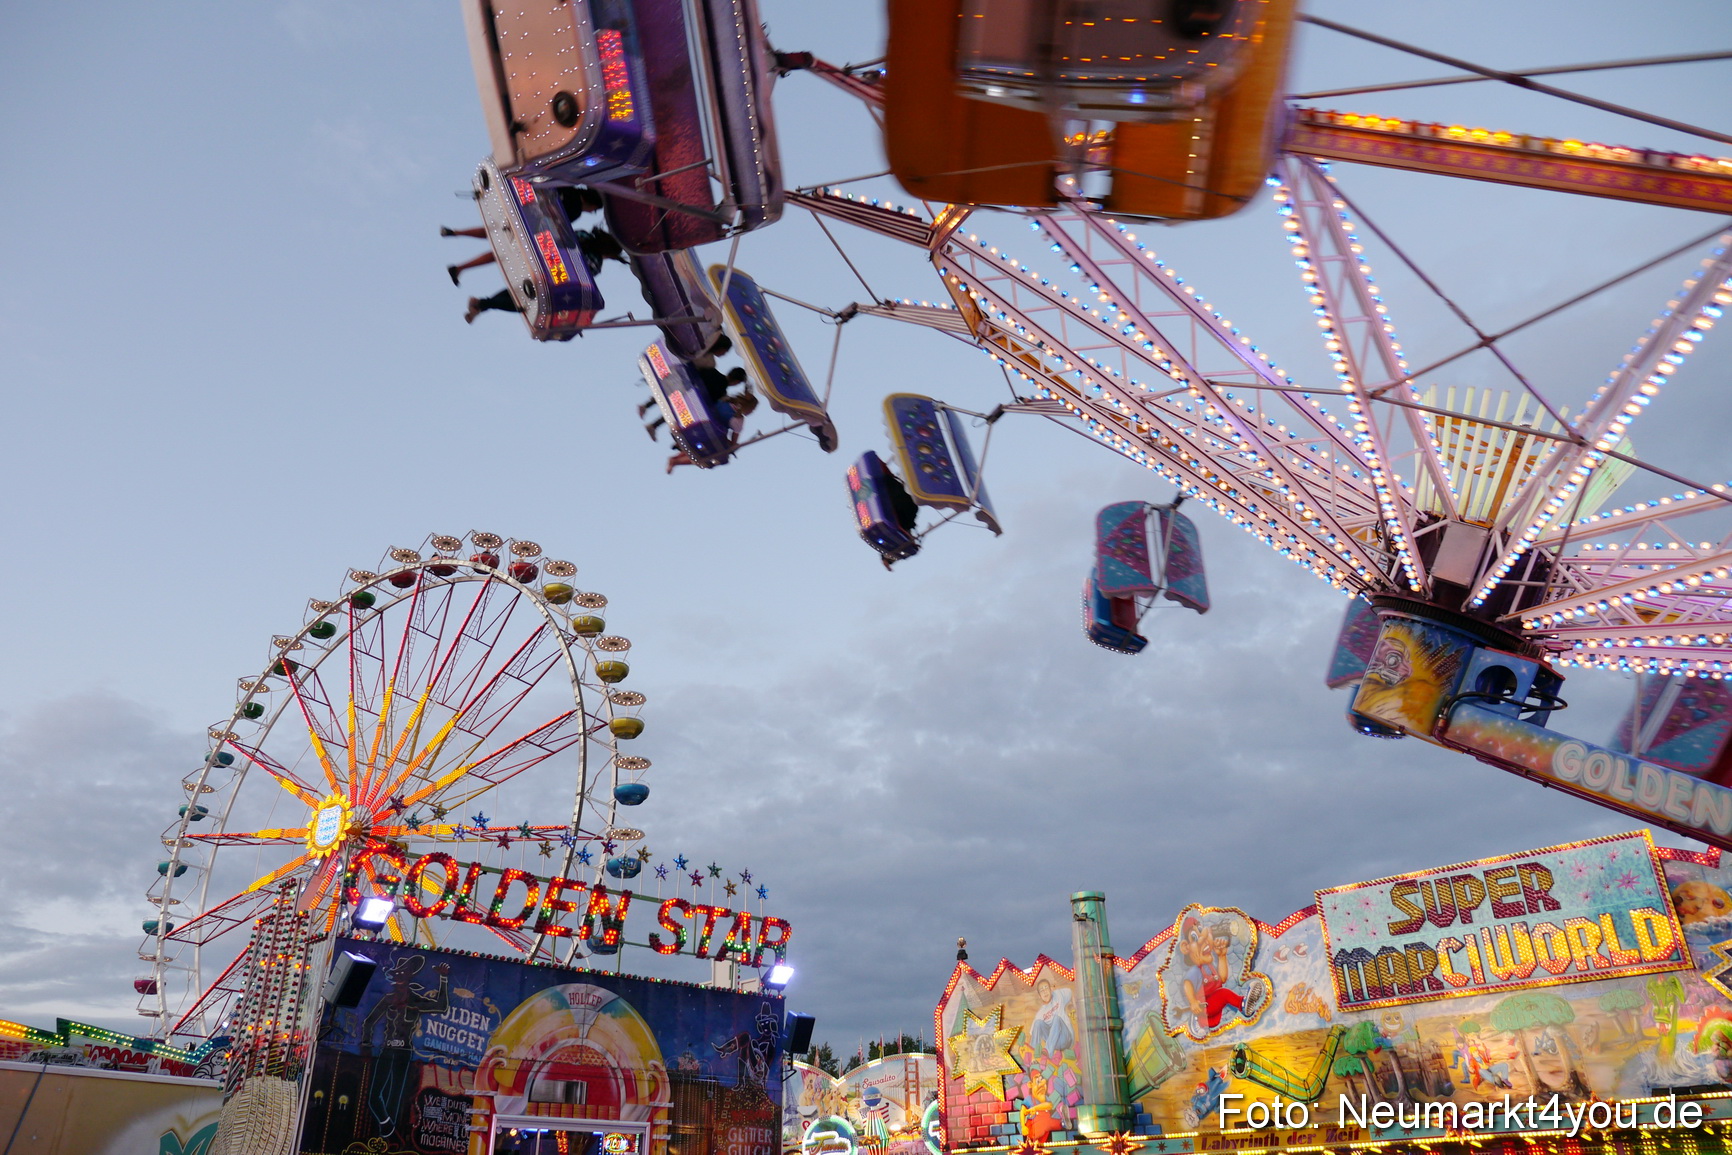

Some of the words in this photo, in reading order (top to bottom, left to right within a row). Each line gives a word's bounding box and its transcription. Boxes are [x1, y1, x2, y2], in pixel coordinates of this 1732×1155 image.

[1552, 740, 1732, 835] GOLDEN
[343, 842, 632, 941] GOLDEN
[649, 897, 792, 968] STAR
[1388, 861, 1562, 936] SUPER
[1333, 905, 1680, 1003] MARCIWORLD
[426, 1018, 485, 1052] NUGGET
[430, 1006, 490, 1031] OLDEN
[424, 1037, 467, 1057] GAMBLING
[862, 1074, 896, 1089] Sausalito
[1201, 1134, 1280, 1150] Labyrinth
[1287, 1131, 1316, 1145] der
[1325, 1126, 1361, 1143] Zeit
